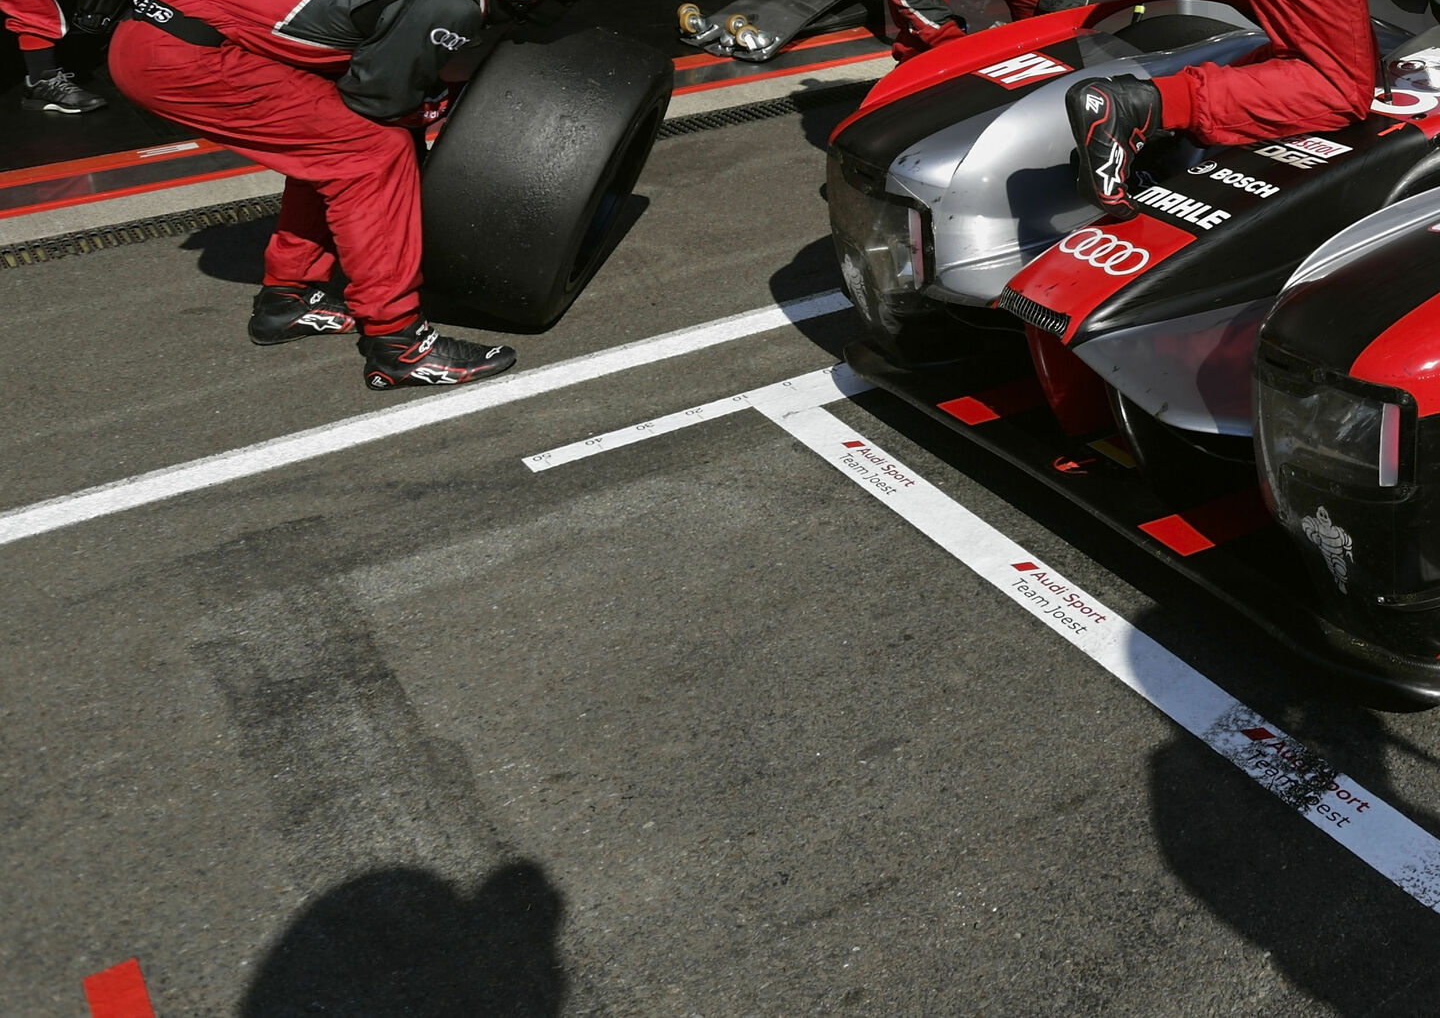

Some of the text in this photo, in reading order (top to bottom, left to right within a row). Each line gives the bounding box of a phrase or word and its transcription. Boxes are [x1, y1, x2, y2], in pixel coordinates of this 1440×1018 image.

[977, 52, 1067, 84] HY
[1209, 168, 1280, 199] BOSCH
[1133, 186, 1232, 231] MAHLE
[838, 453, 897, 496] Team Joest
[857, 446, 916, 488] Audi Sport
[1012, 578, 1088, 635] Team Joest
[1030, 571, 1107, 624] Audi Sport
[1250, 750, 1351, 828] Team oest
